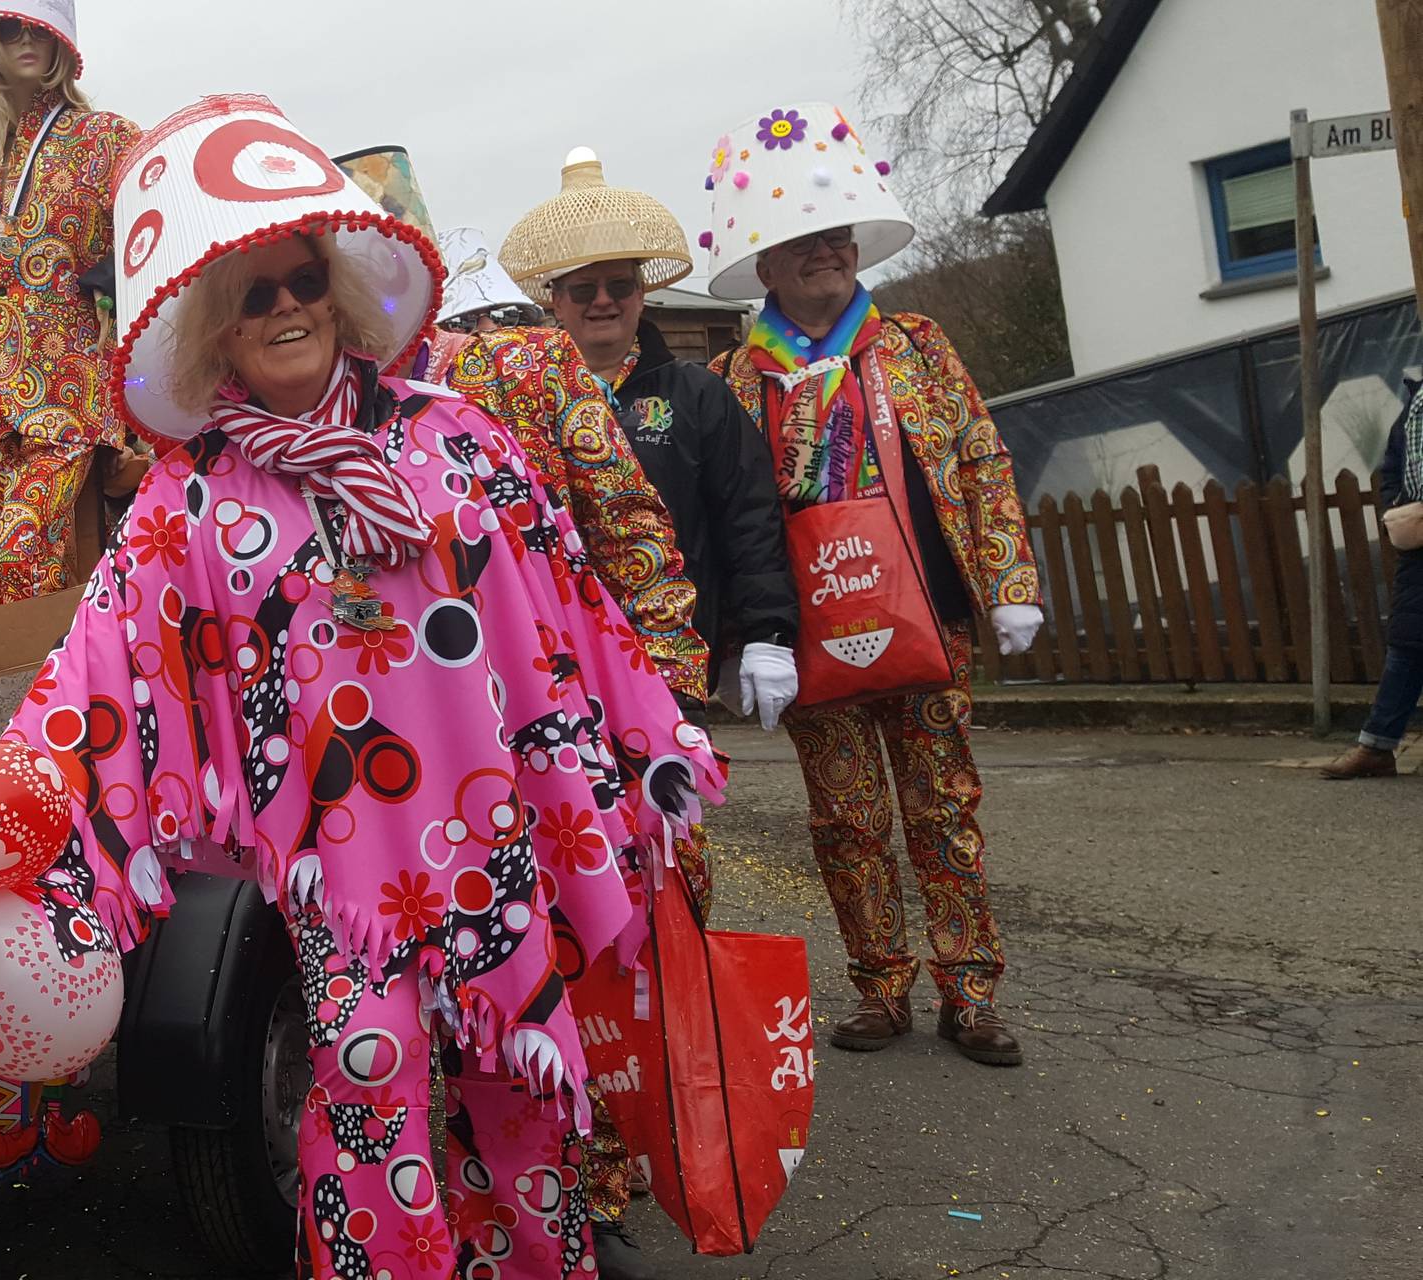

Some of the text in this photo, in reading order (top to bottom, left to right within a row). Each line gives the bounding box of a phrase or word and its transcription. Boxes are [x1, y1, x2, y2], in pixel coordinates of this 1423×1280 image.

[1327, 117, 1393, 148] Am Bl
[779, 446, 800, 479] 200
